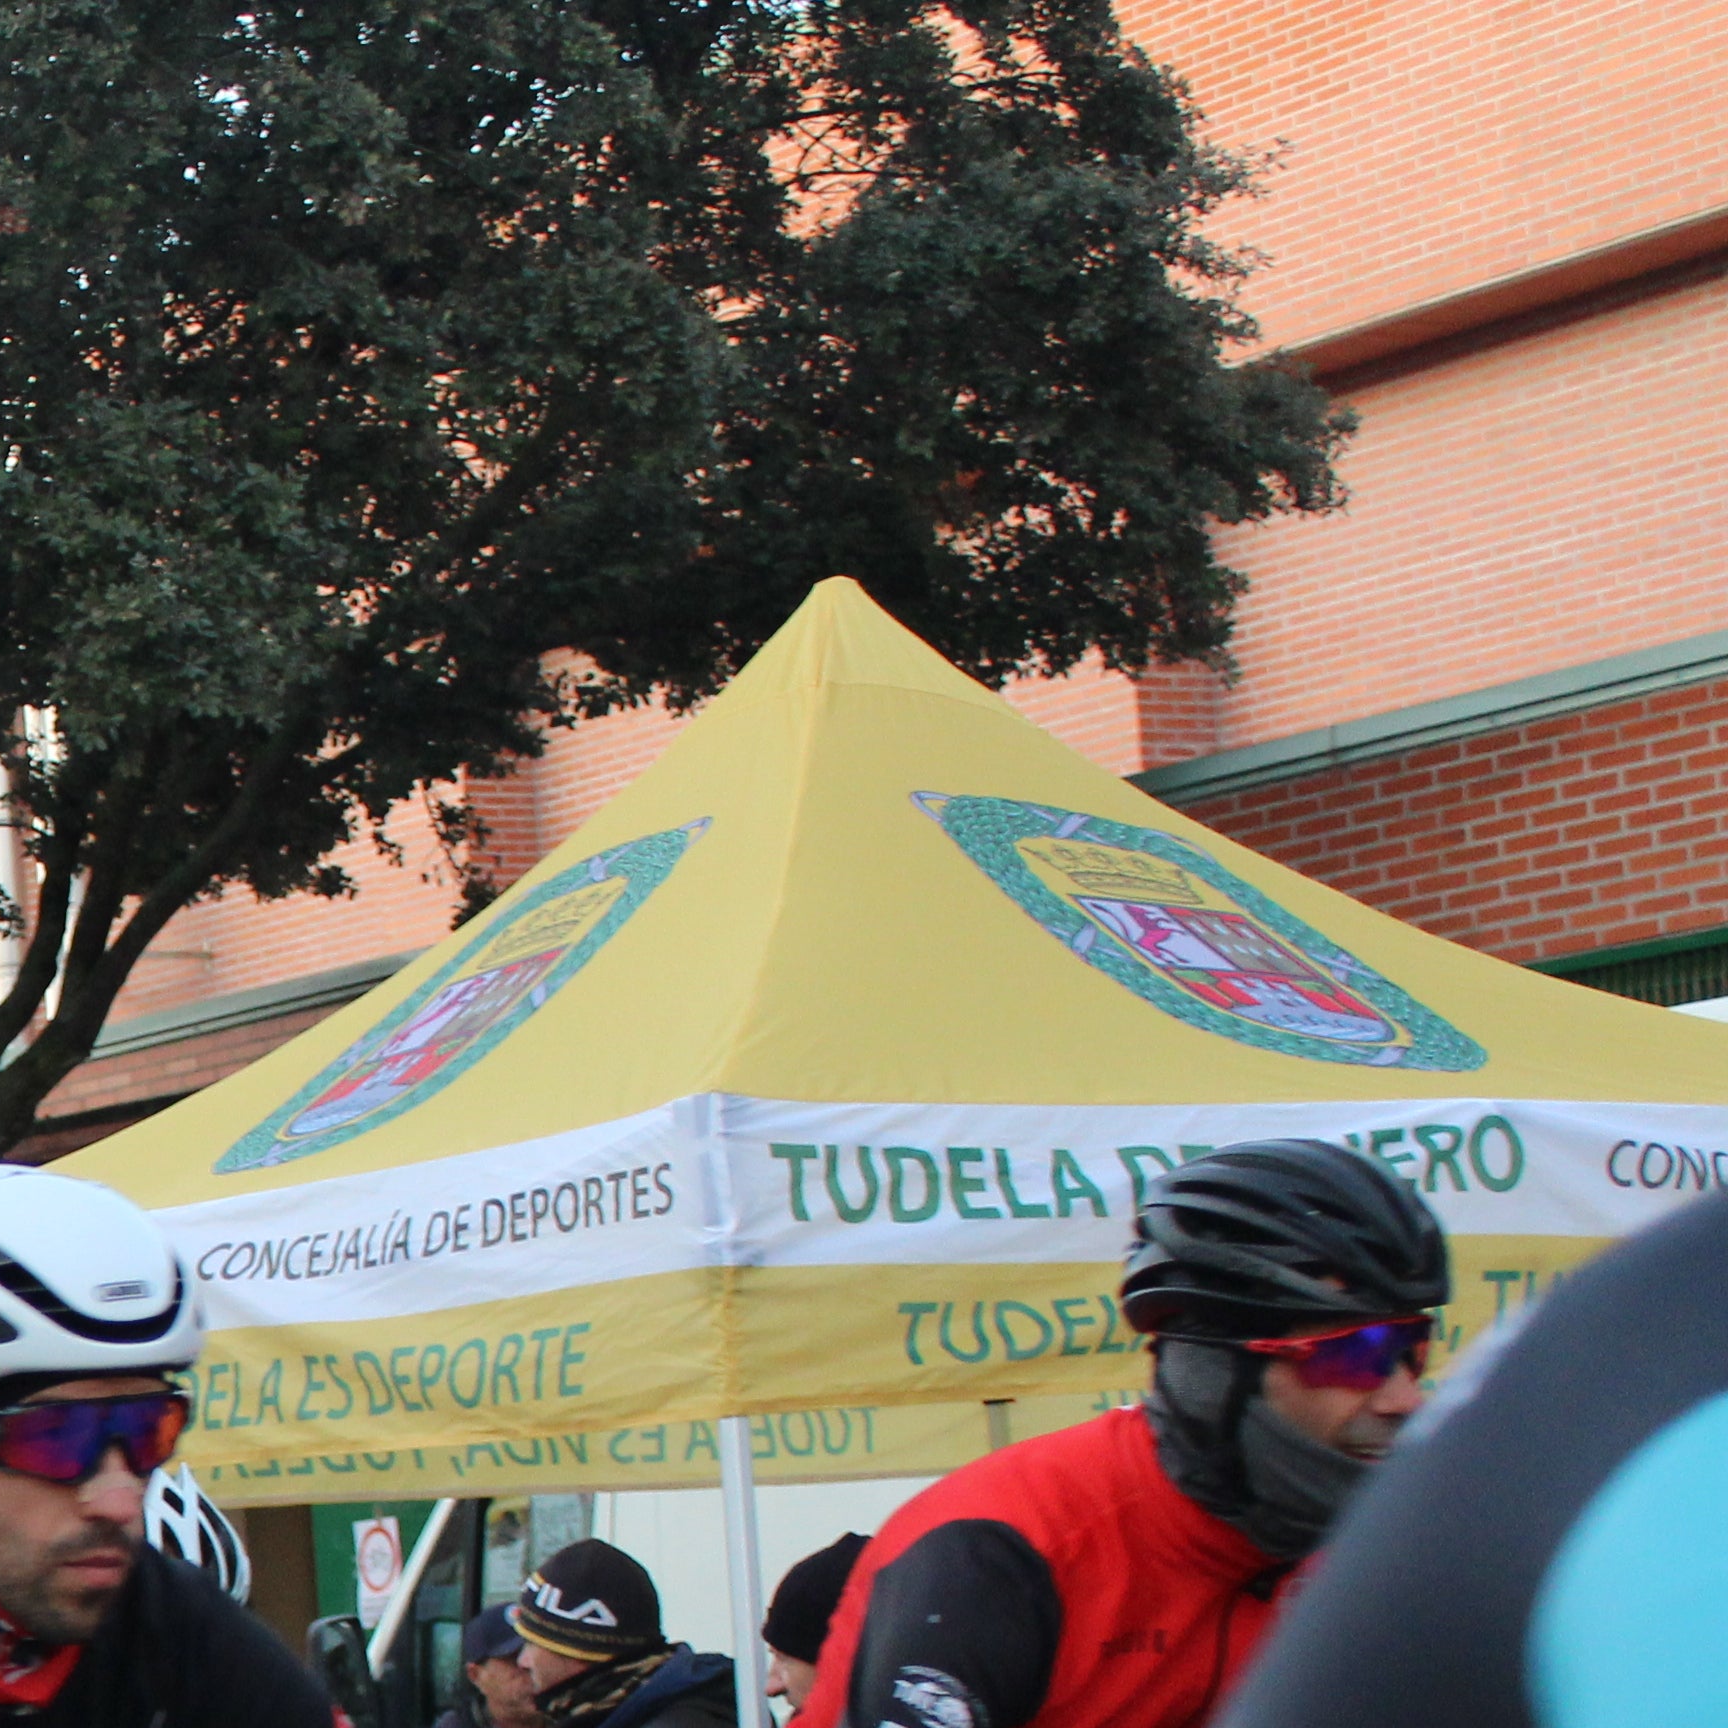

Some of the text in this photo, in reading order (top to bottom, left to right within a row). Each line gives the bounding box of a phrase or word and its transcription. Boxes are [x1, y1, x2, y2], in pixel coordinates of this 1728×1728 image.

[196, 1162, 674, 1282] CONCEJALÍA DE DEPORTES
[772, 1143, 1108, 1223] TUDELA
[1117, 1144, 1213, 1216] D
[295, 1352, 355, 1421] ES
[350, 1321, 592, 1416] DEPORTE
